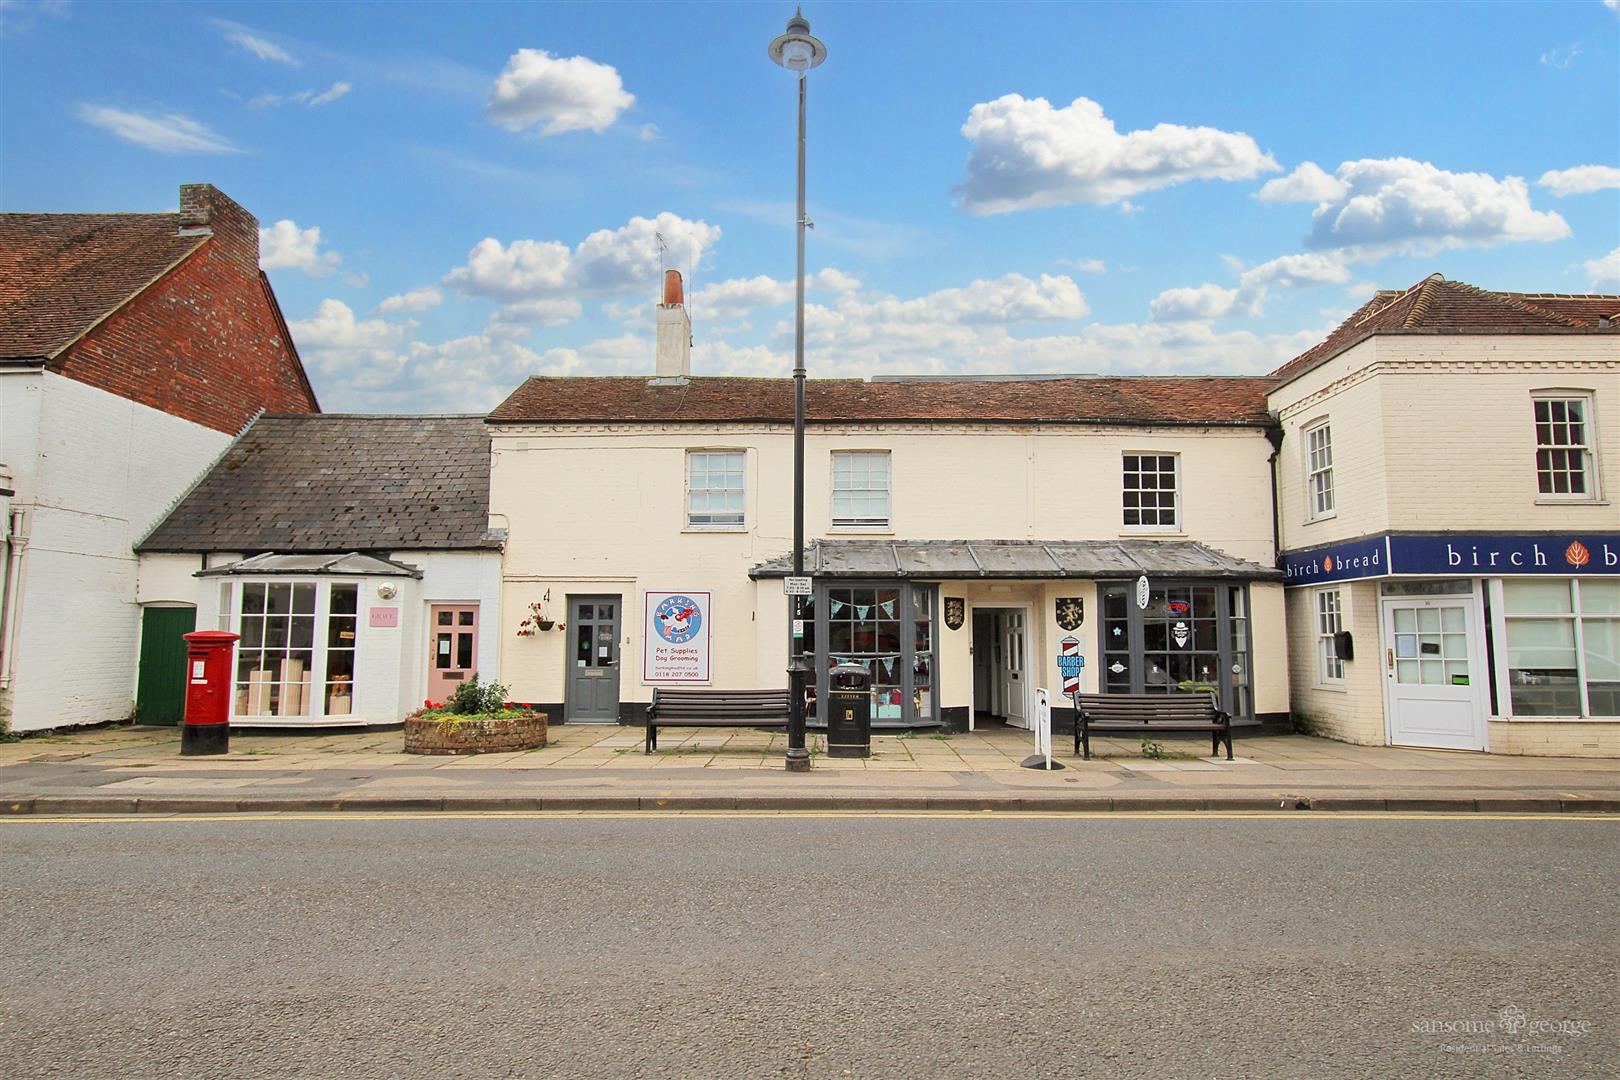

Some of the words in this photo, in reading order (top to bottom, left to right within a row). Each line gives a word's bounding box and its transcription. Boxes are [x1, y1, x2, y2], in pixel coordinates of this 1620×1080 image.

[1447, 544, 1547, 566] birch
[1287, 560, 1319, 577] birch
[1336, 549, 1379, 571] bread
[665, 634, 690, 643] MAD
[670, 647, 698, 655] Supplies
[1058, 656, 1084, 667] BARBER
[1062, 667, 1080, 677] SHOP
